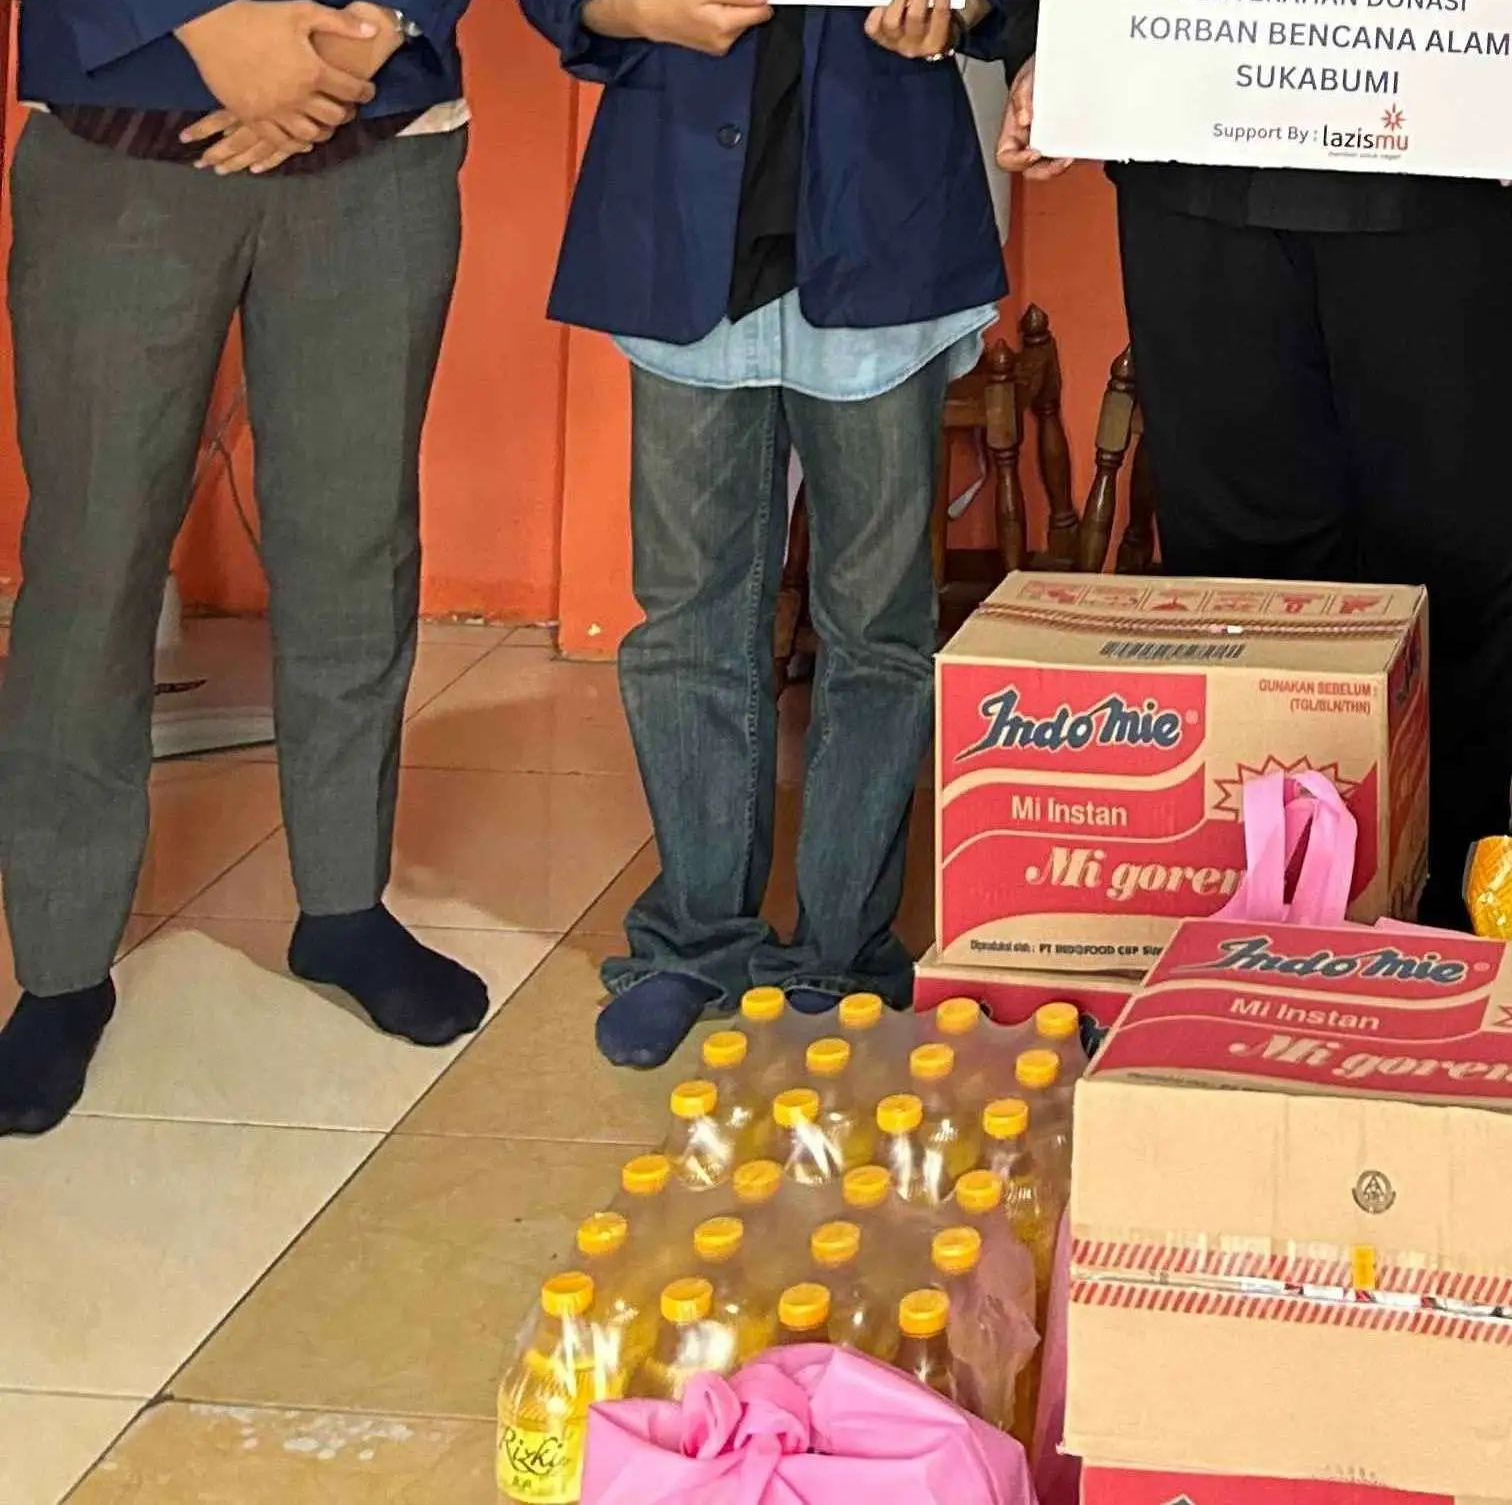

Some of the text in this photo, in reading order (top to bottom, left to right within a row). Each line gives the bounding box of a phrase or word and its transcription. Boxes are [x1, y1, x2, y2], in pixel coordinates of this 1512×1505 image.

[1129, 15, 1511, 56] KORBAN BENCANA ALAM
[1236, 64, 1400, 95] SUKABUMI
[1213, 122, 1282, 142] Support
[1322, 123, 1409, 151] lazismu
[1258, 678, 1315, 692] GUNAKAN
[1011, 795, 1128, 826] Mi Instan
[1024, 845, 1106, 888] Mi
[1229, 997, 1381, 1031] Mi Instan
[1228, 1032, 1344, 1067] Mi
